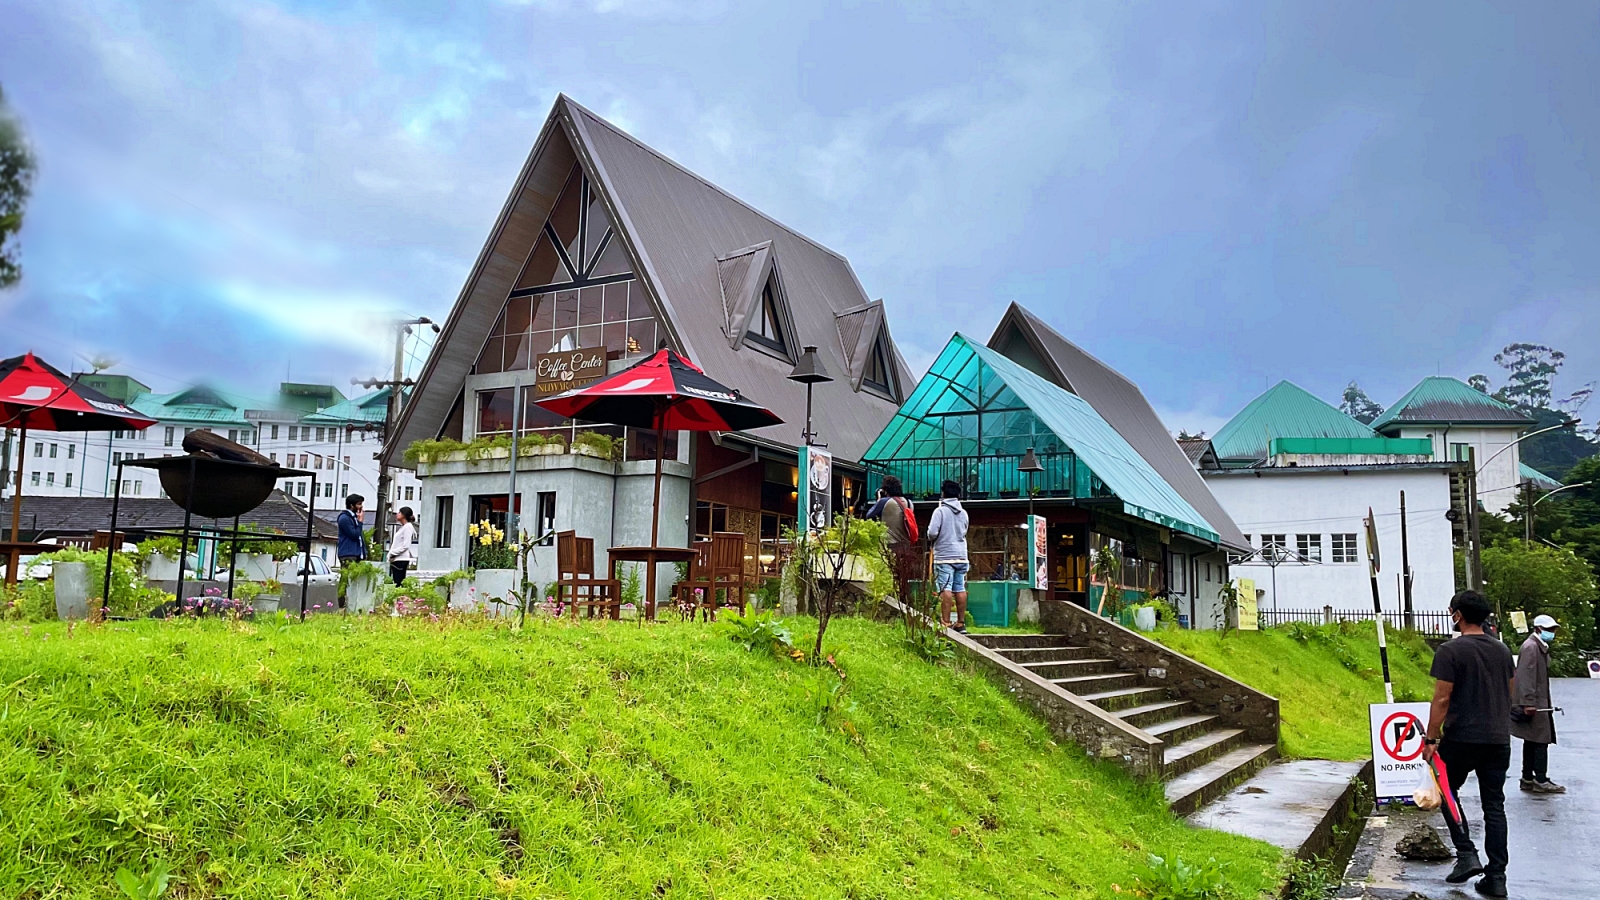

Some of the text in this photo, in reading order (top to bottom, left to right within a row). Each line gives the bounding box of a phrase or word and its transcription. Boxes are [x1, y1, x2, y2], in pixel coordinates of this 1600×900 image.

[538, 353, 602, 378] Coffee Center
[538, 382, 576, 392] NUWARA
[1394, 722, 1416, 752] P
[1395, 762, 1425, 771] PARKIN
